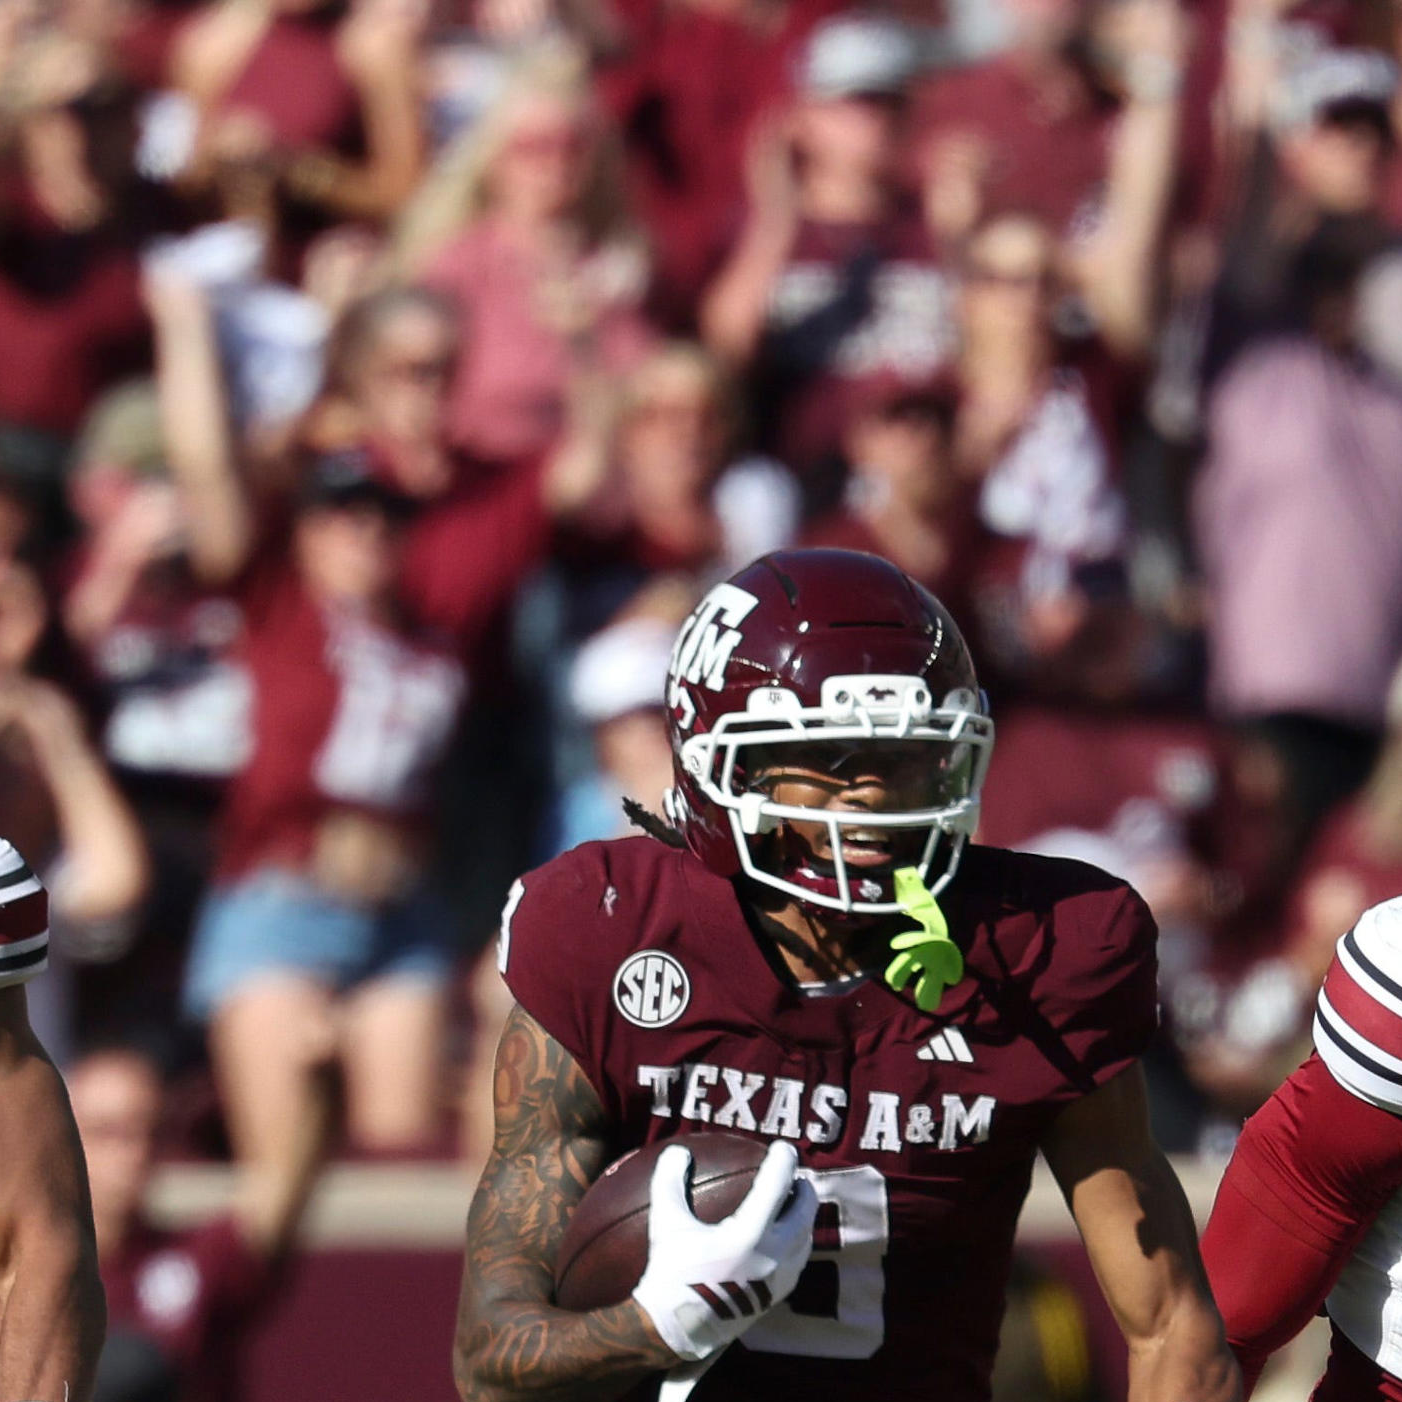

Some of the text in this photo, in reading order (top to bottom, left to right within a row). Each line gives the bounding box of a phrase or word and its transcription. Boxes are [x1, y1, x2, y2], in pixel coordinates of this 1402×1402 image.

[619, 955, 685, 1024] SEC
[637, 1063, 997, 1153] TEXAS A&M
